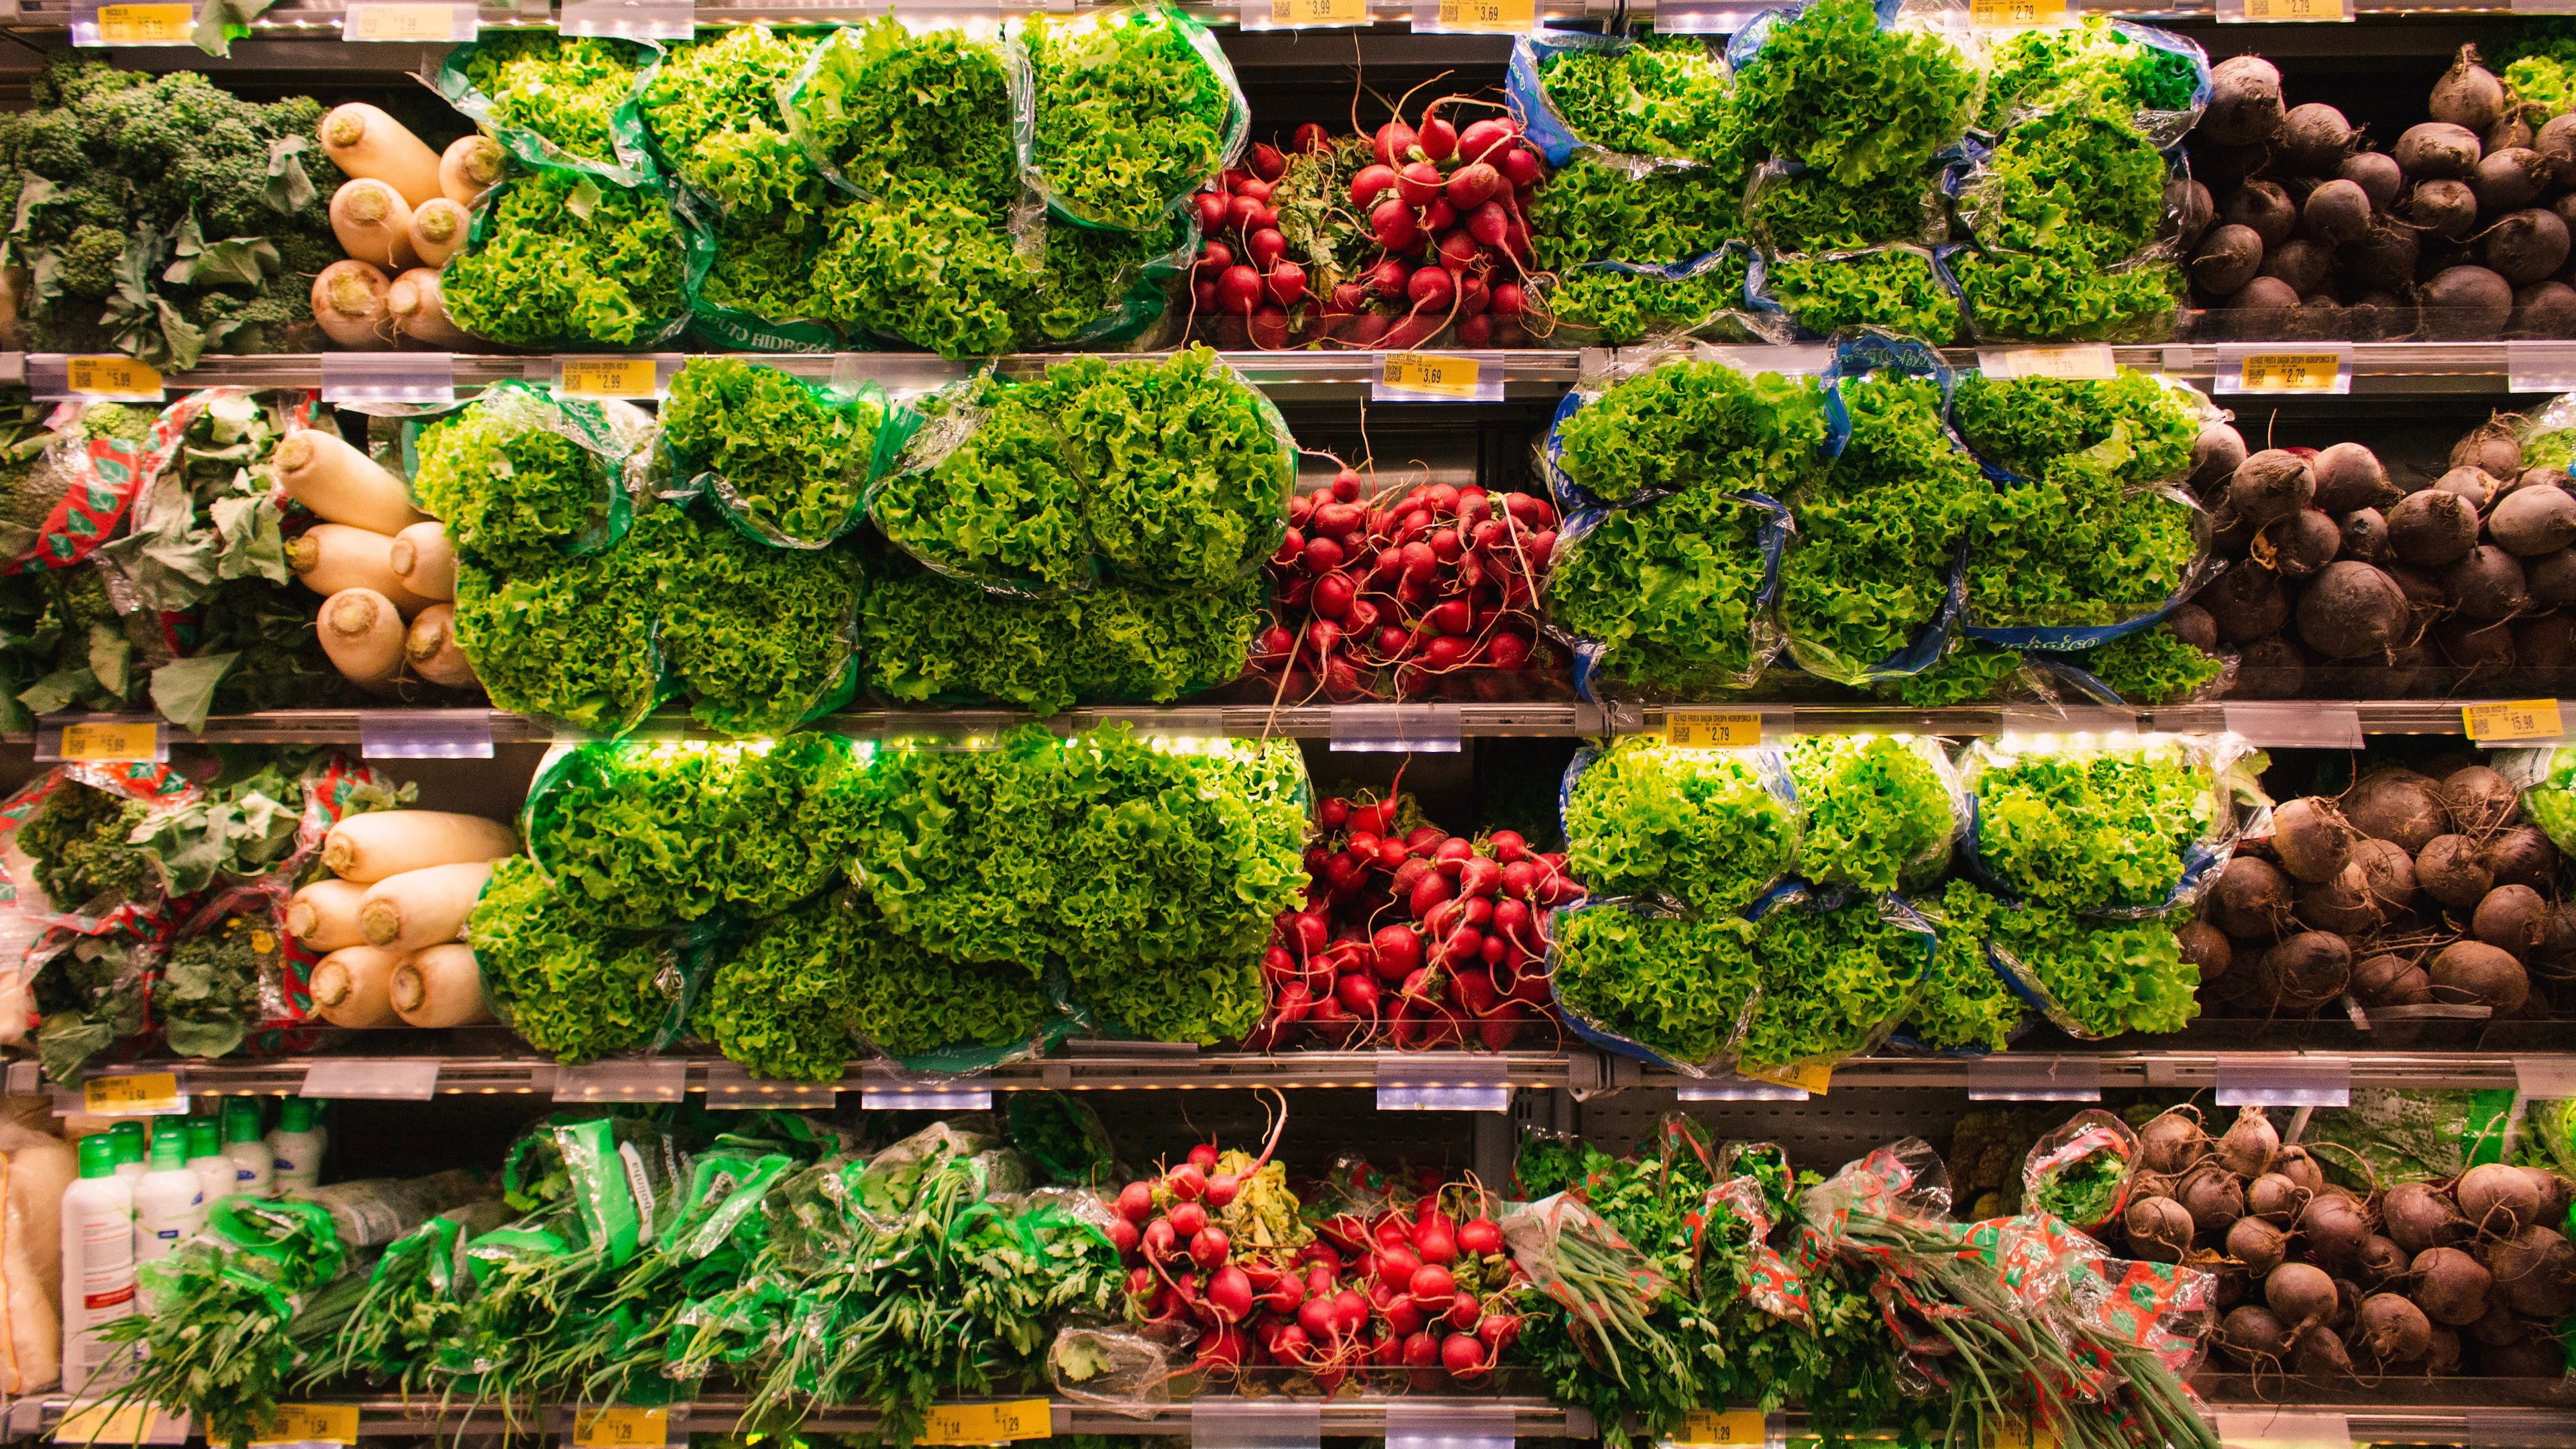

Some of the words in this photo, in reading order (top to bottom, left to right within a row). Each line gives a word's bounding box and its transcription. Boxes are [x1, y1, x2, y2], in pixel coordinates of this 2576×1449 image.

[1312, 0, 1330, 16] 3,99
[1481, 6, 1498, 22] 3,69
[2016, 5, 2034, 22] 2,79
[2054, 361, 2074, 373] 2,79
[1424, 368, 1442, 384] 3,69
[2287, 368, 2306, 384] 2,79
[1673, 714, 1687, 722] ALFACE
[1688, 714, 1699, 722] FRUTA
[1713, 714, 1727, 722] CRESPA
[2511, 714, 2534, 730] 15,98
[1712, 727, 1729, 743] 2,79
[944, 1421, 960, 1436] 1,14
[1002, 1416, 1019, 1433] 1,29
[1714, 1426, 1730, 1442] 1,29
